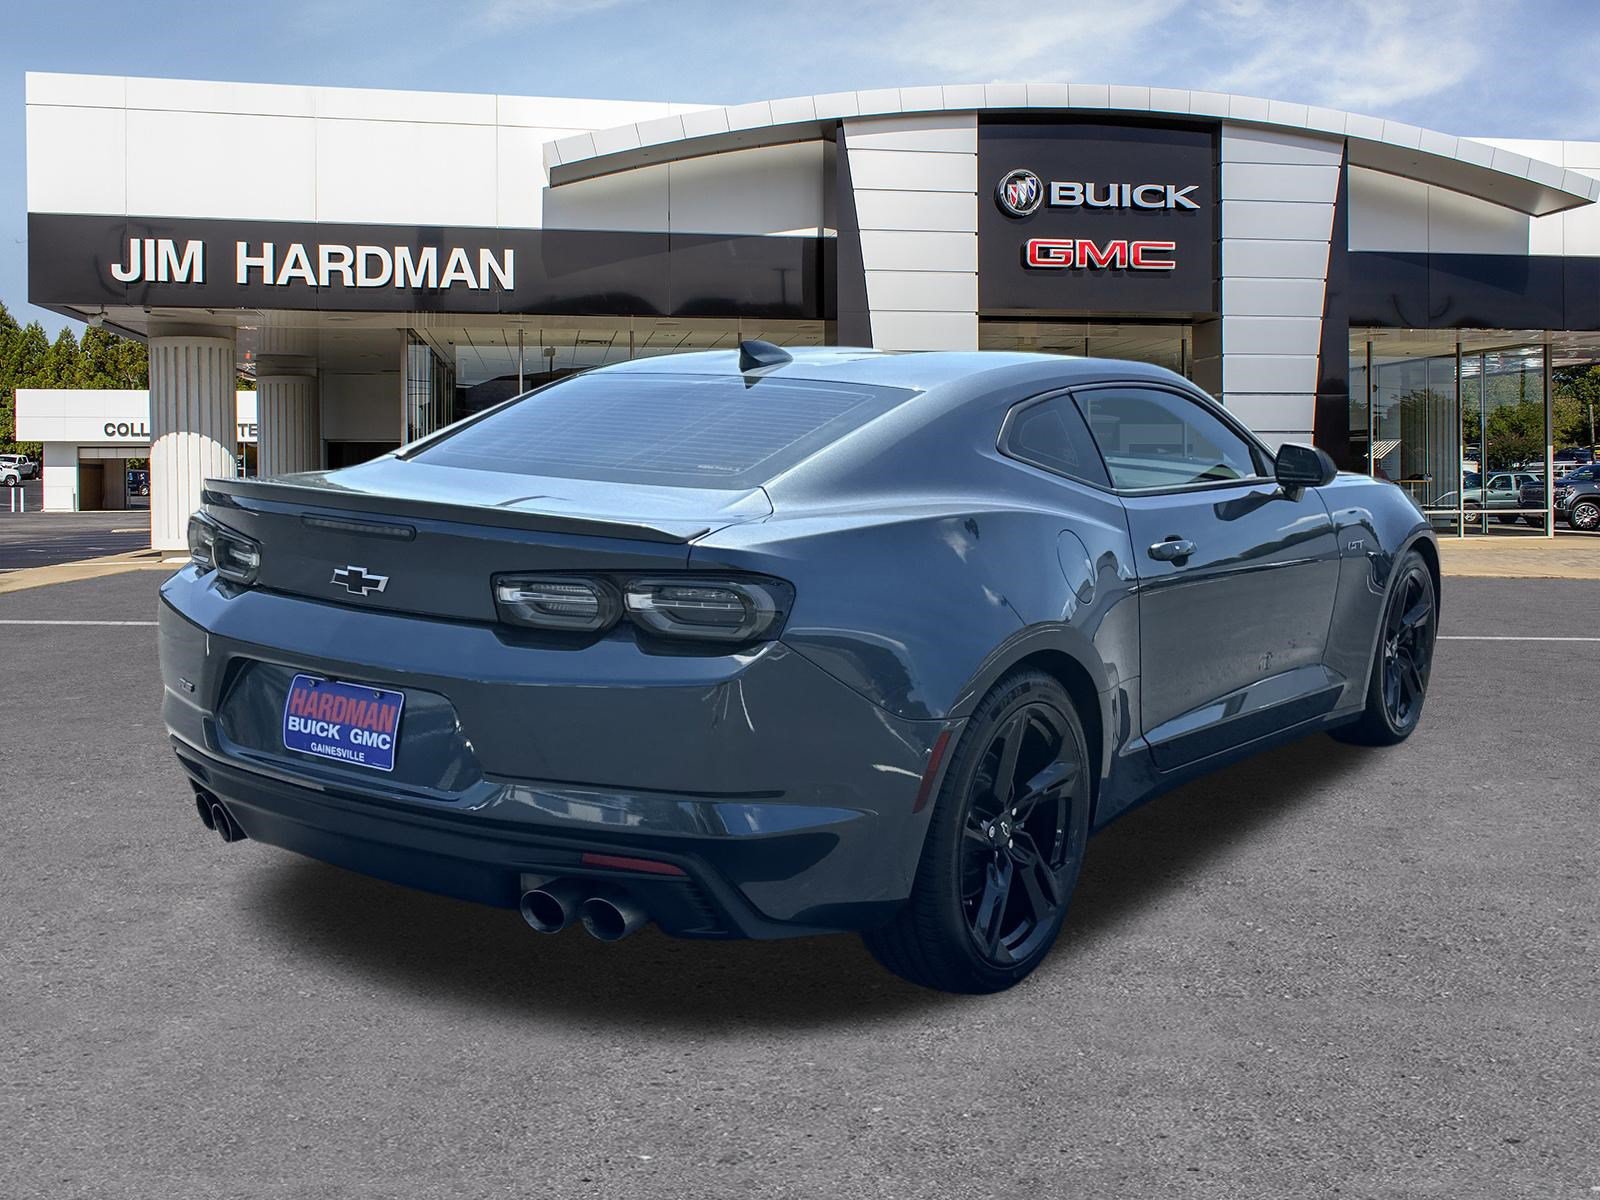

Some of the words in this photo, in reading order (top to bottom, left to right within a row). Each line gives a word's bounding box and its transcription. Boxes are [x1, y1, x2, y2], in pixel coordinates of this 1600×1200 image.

[1050, 181, 1200, 209] BUICK
[111, 238, 203, 284] JIM
[236, 241, 514, 291] HARDMAN
[1026, 238, 1176, 270] GMC
[290, 687, 396, 732] HARDMAN
[288, 716, 340, 740] BUICK
[349, 728, 391, 750] GMC
[310, 742, 365, 761] GAINESVILLE
